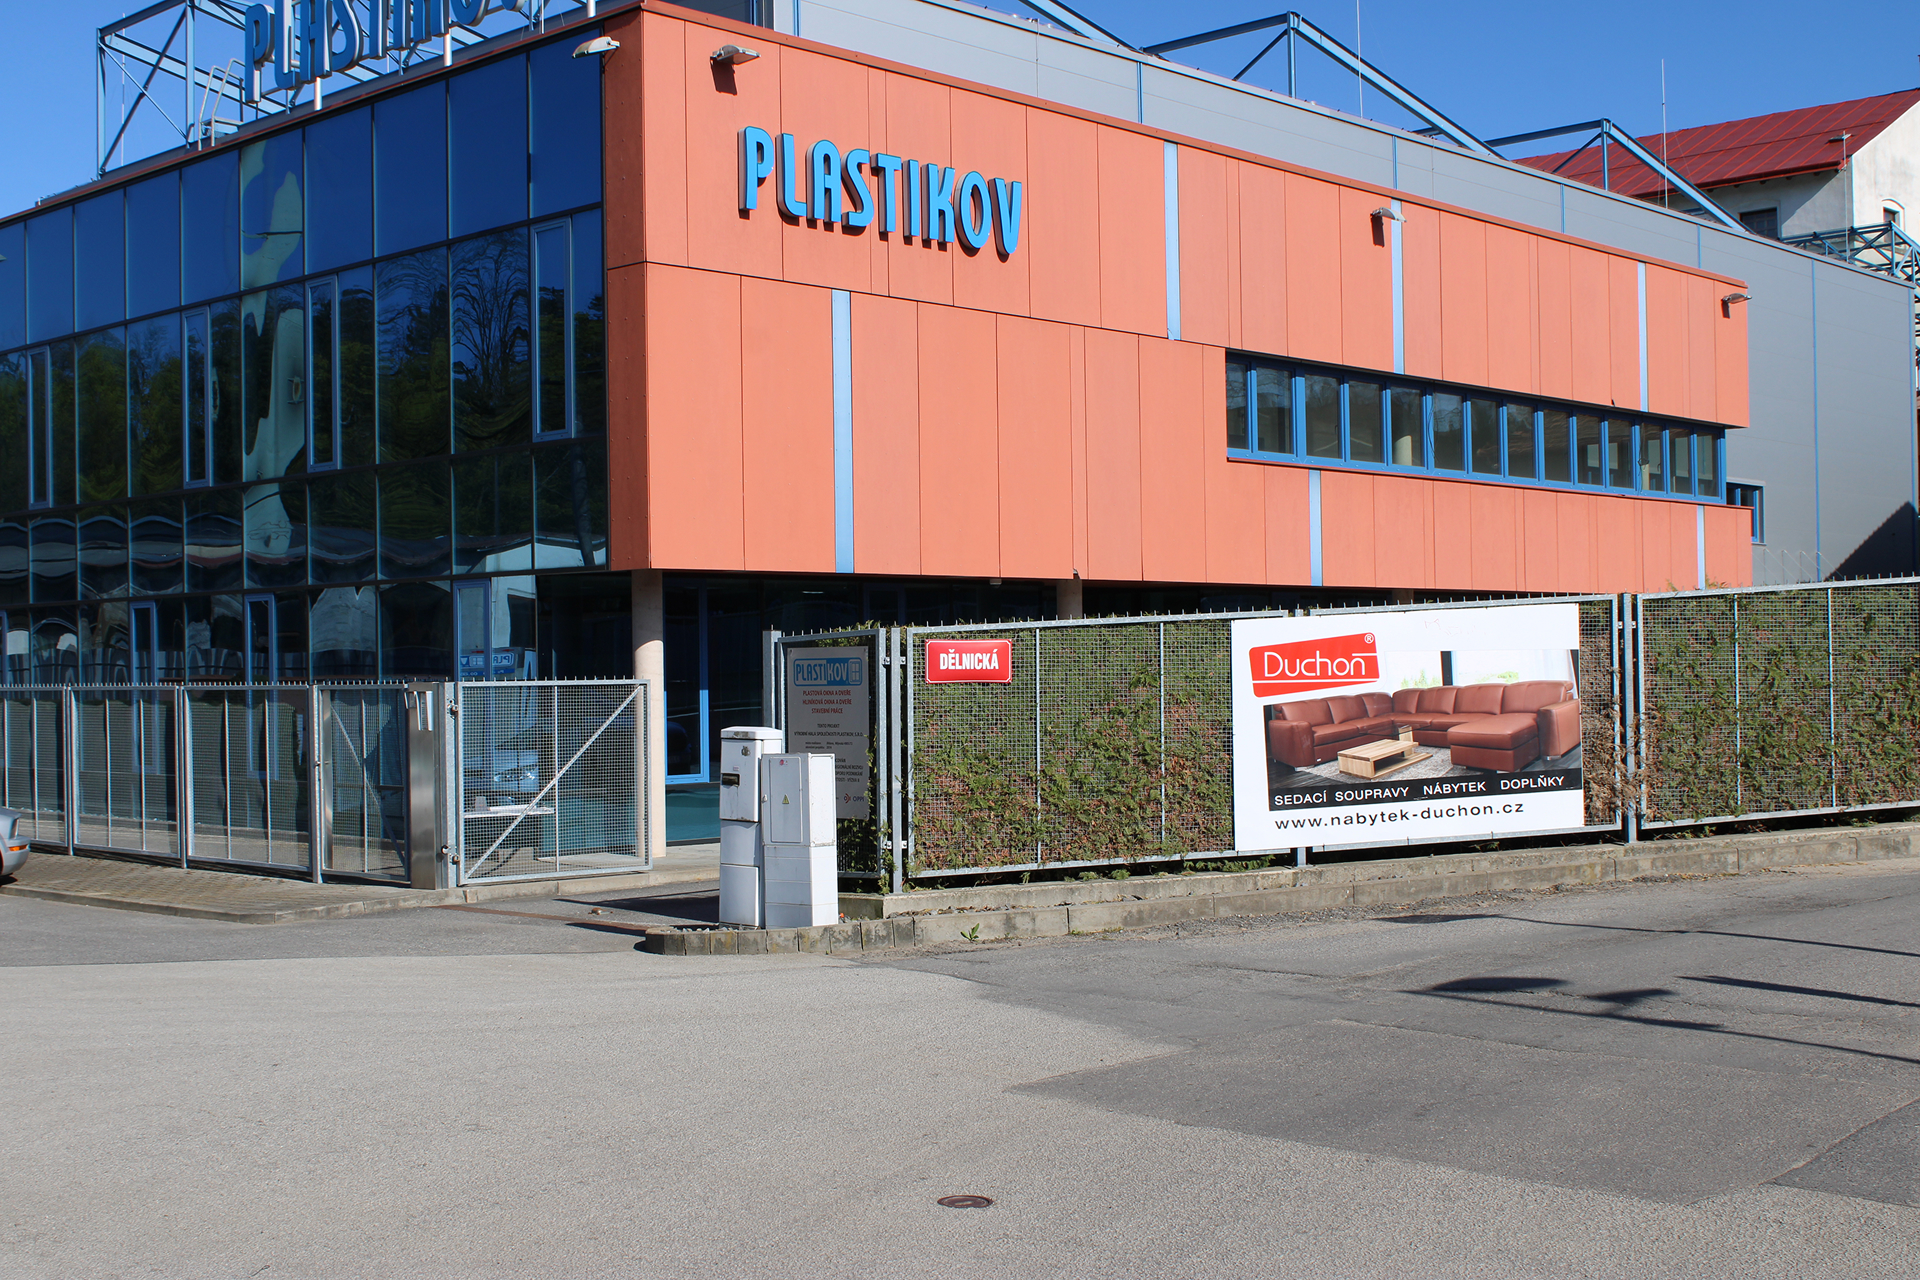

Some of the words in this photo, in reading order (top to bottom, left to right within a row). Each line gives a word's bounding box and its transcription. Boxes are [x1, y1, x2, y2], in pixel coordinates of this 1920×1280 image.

[738, 126, 1022, 256] PLASTIKOV
[795, 662, 848, 682] PLASTIKOV
[940, 648, 999, 670] DĚLNICKÁ
[1274, 790, 1327, 806] SEDACÍ
[1334, 786, 1410, 802] SOUPRAVY
[1423, 781, 1487, 795] NÁBYTEK
[1500, 775, 1565, 790] DOPLŇKY
[1274, 803, 1524, 830] www.nabytek-duchon.cz
